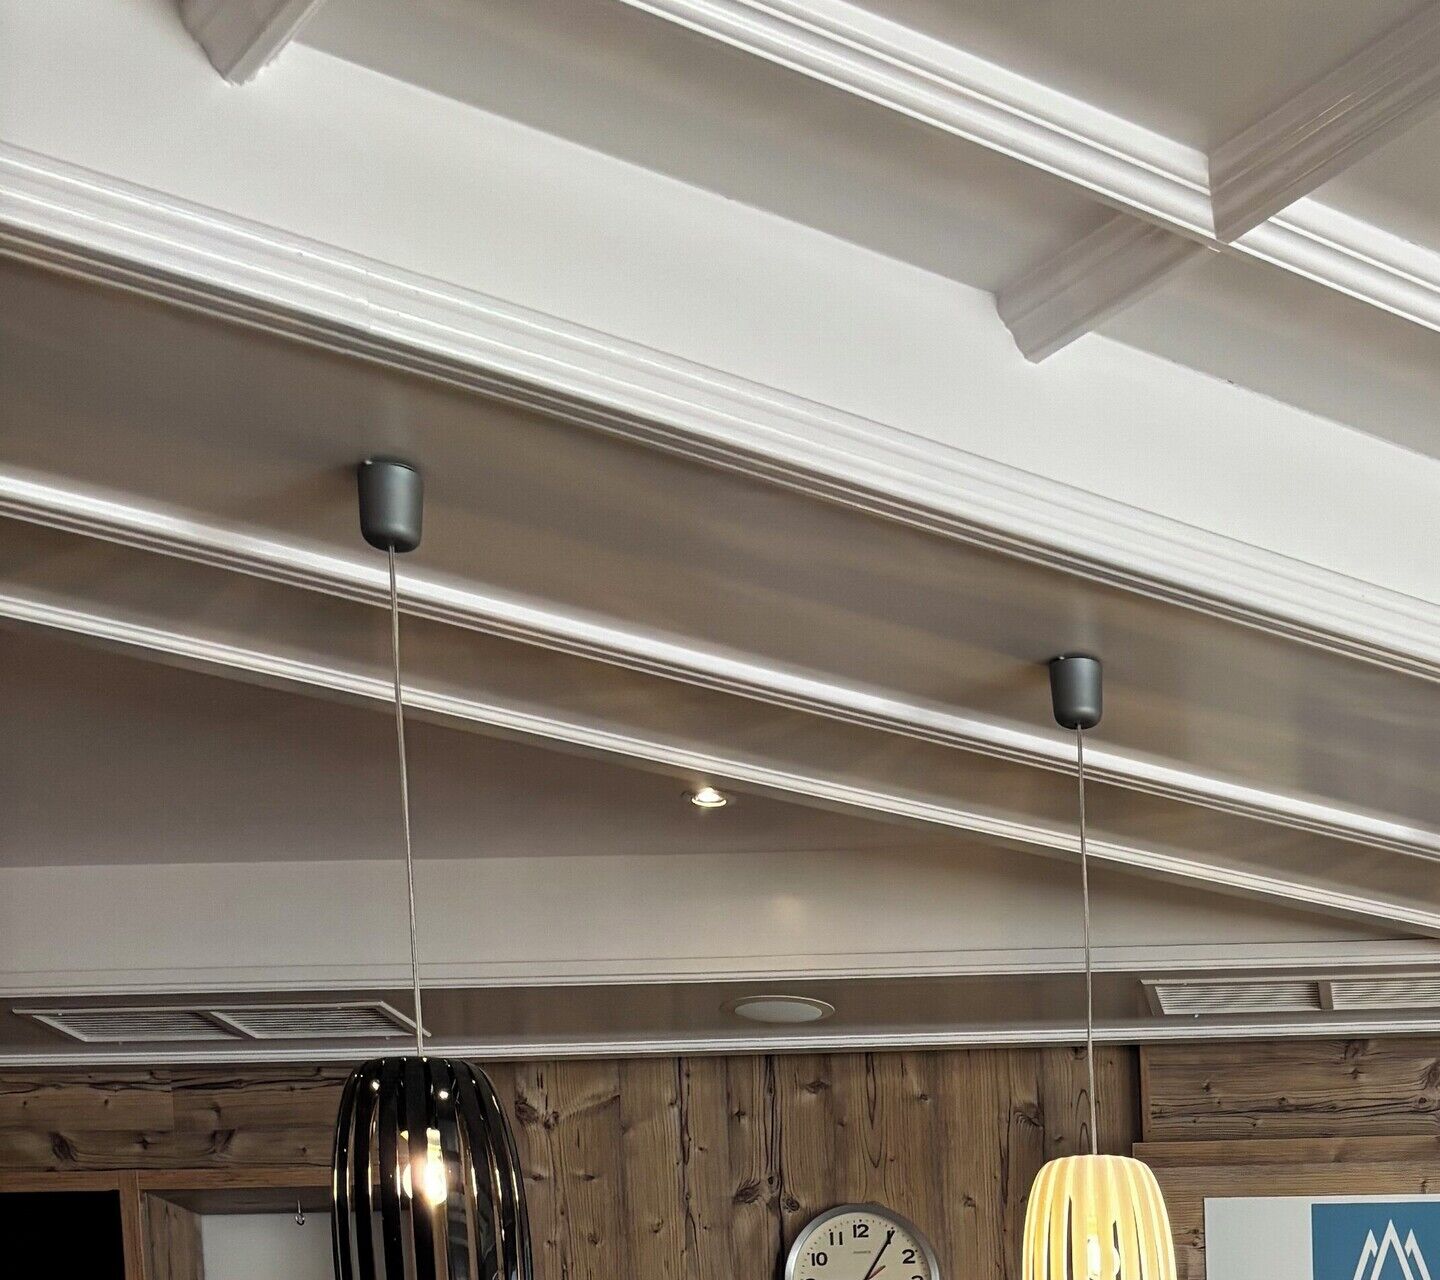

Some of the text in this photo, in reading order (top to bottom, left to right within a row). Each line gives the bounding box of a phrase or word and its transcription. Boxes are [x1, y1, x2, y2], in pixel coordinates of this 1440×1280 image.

[853, 1224, 869, 1238] 12
[829, 1231, 843, 1246] 11
[811, 1252, 828, 1266] 10
[902, 1249, 916, 1264] 2
